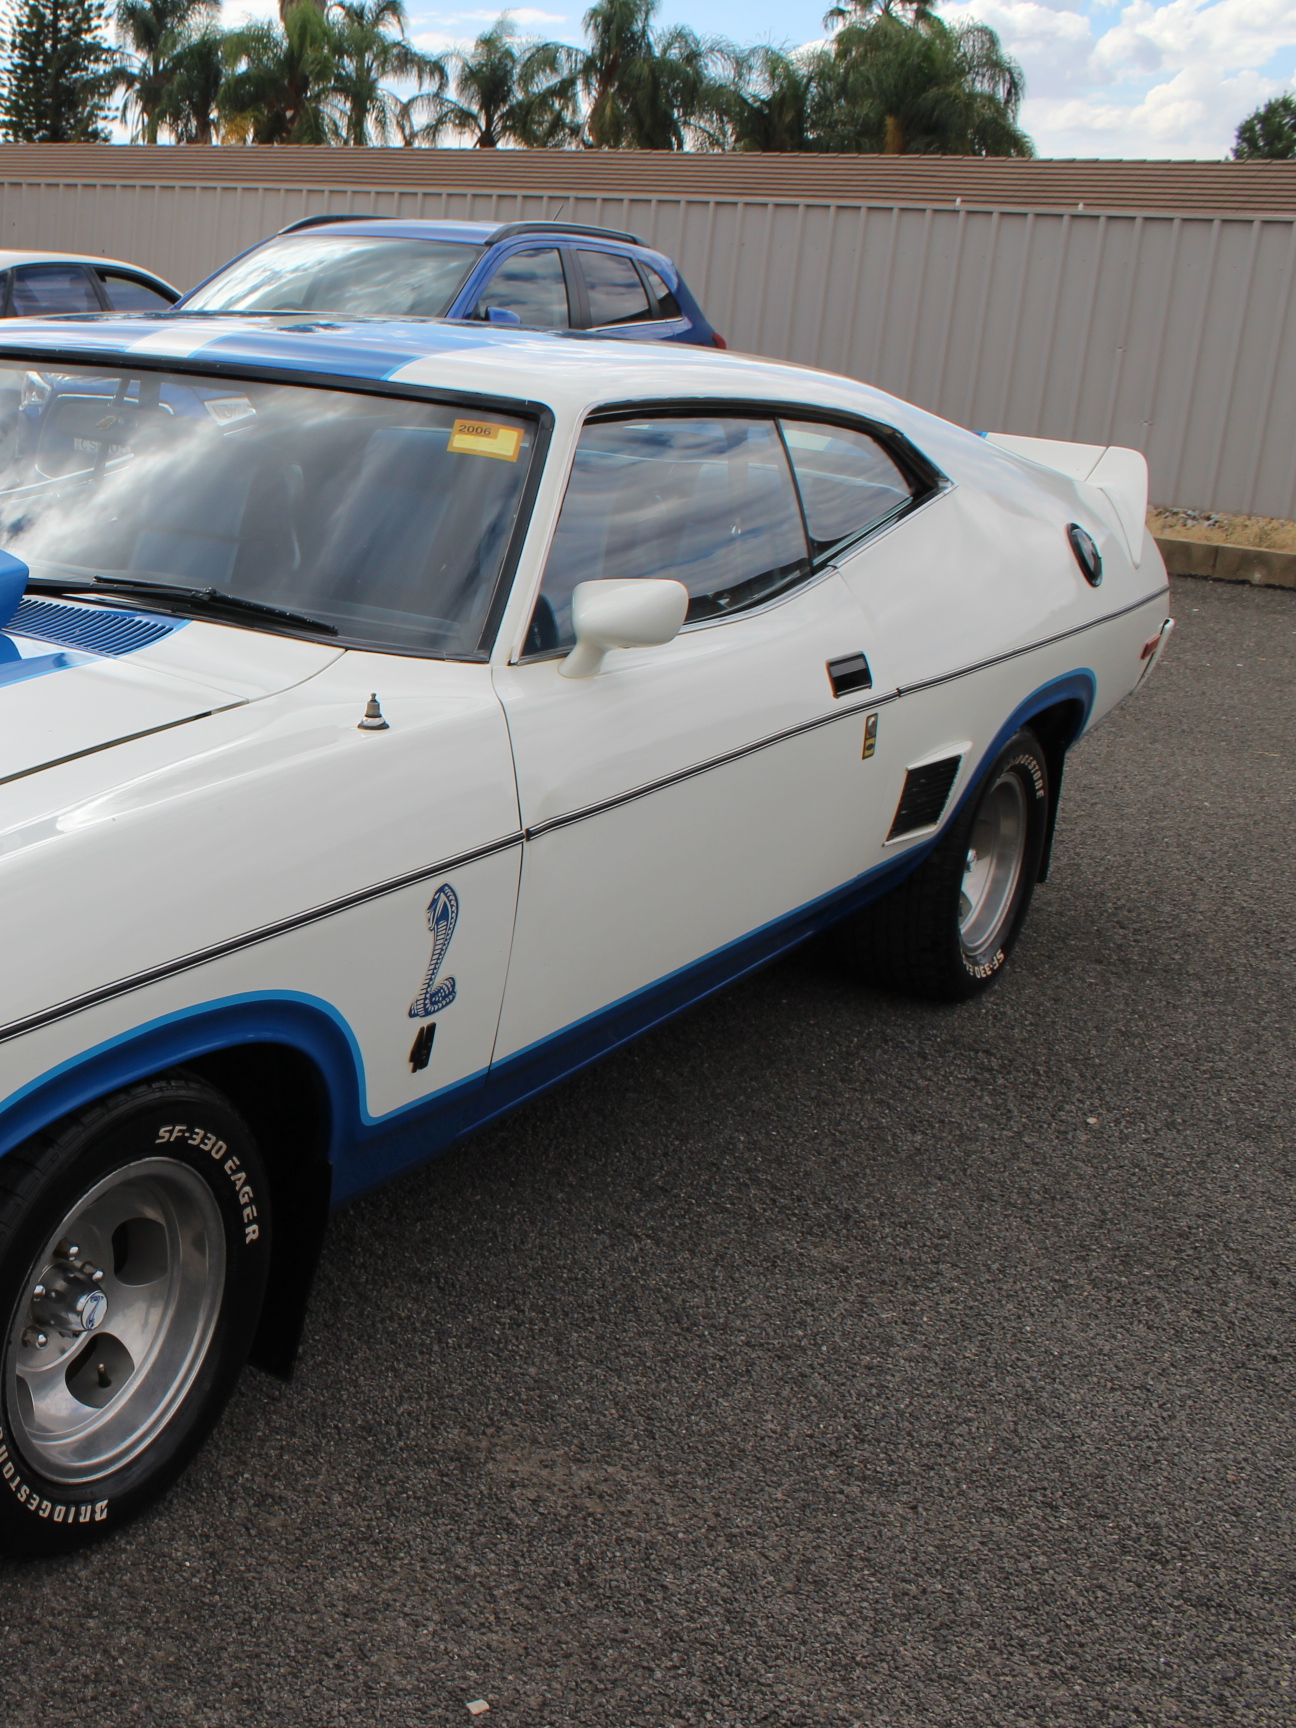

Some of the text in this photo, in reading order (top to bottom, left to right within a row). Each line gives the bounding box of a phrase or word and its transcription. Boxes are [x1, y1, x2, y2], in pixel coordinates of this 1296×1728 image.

[458, 424, 492, 436] 2006
[155, 1125, 260, 1245] SF-330 EAGER
